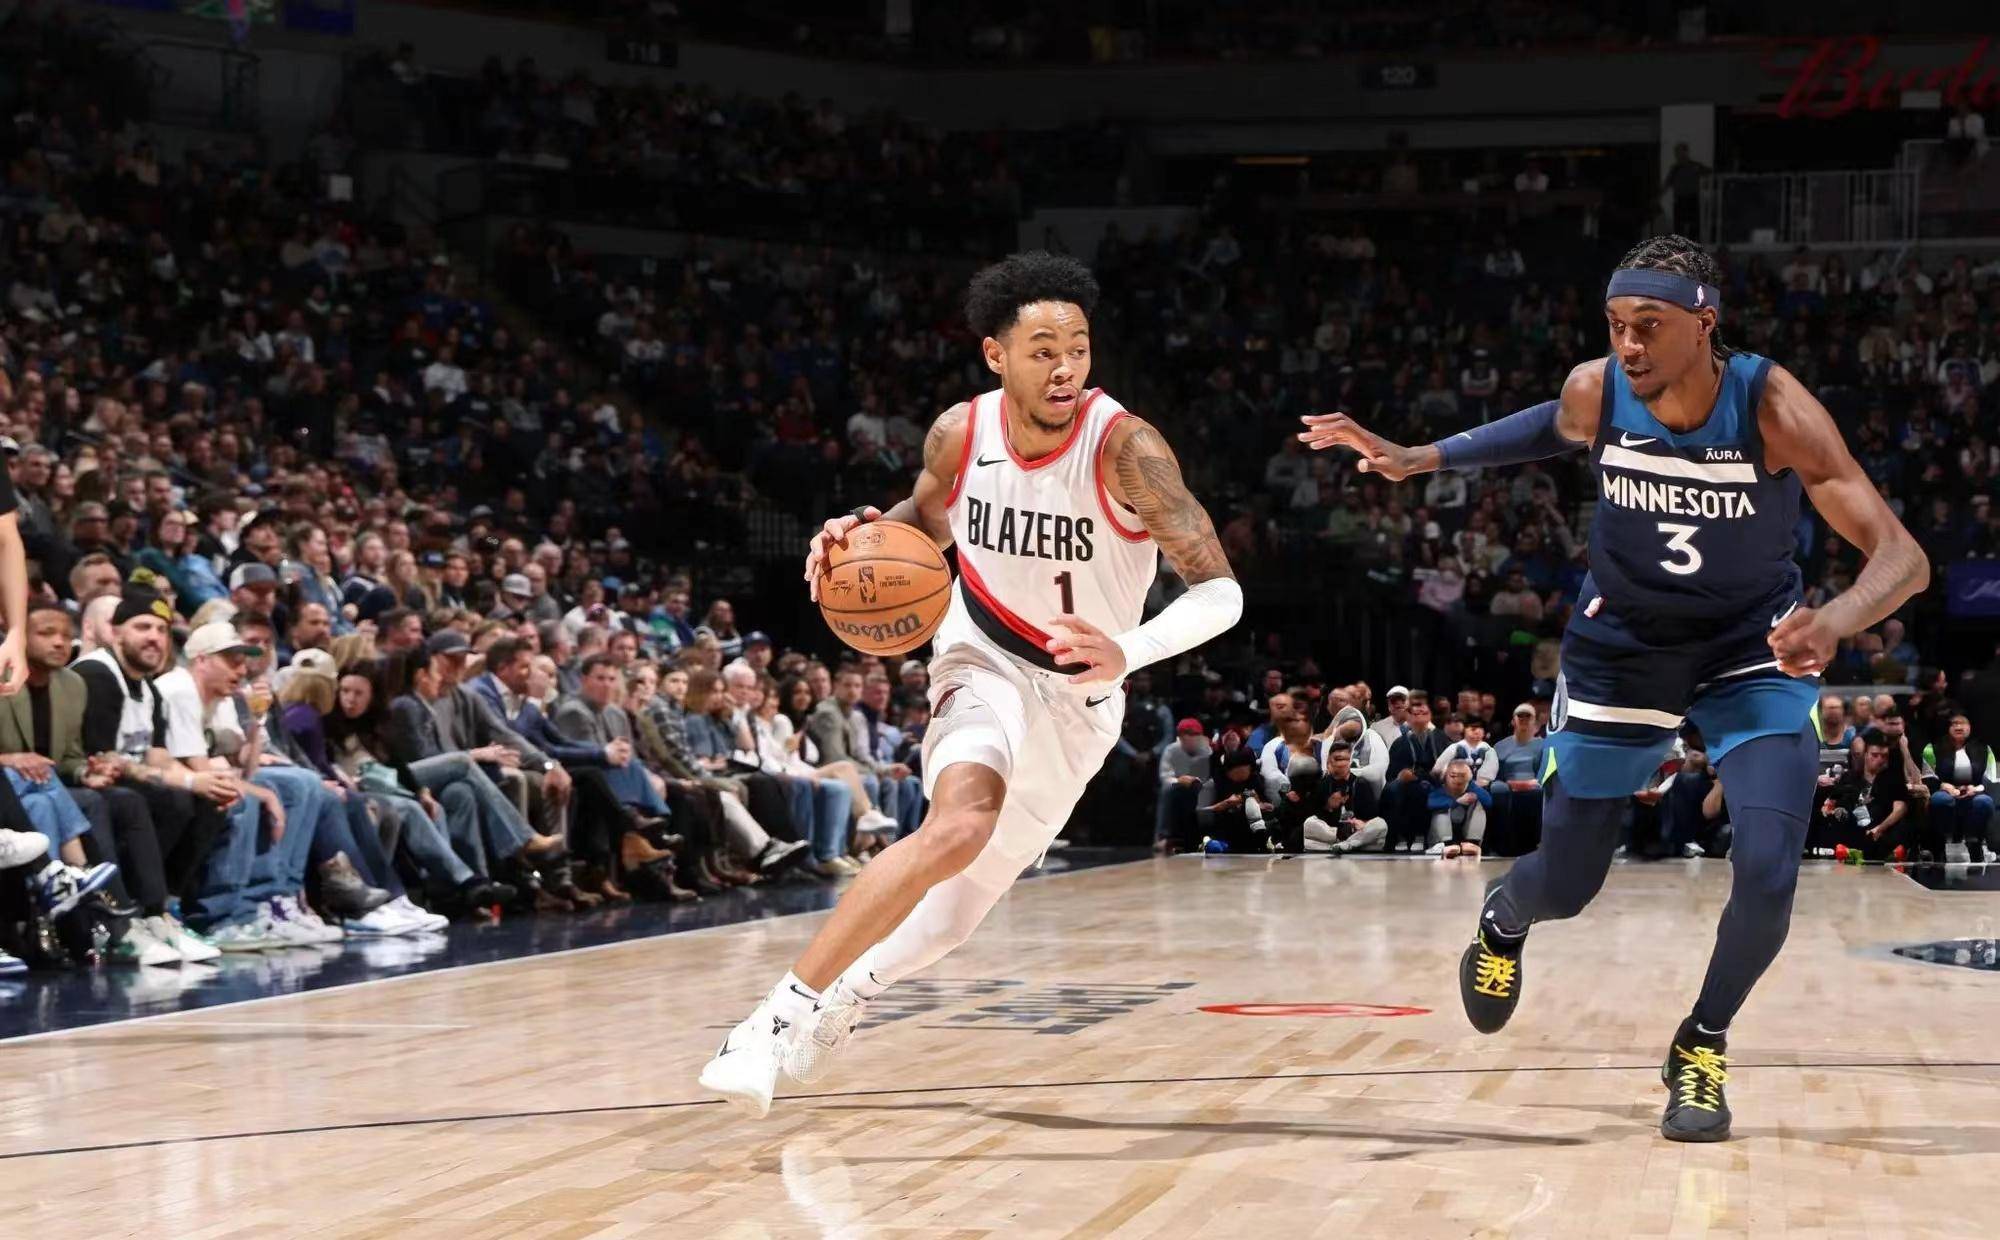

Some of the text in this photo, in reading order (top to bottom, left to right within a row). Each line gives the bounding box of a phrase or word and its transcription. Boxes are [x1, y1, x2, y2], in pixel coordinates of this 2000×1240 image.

[1381, 65, 1416, 85] 120
[1602, 470, 1757, 519] MINNESOTA
[967, 495, 1094, 562] BLAZERS
[1657, 522, 1703, 575] 3
[1054, 571, 1075, 615] 1
[833, 612, 924, 642] Wilson
